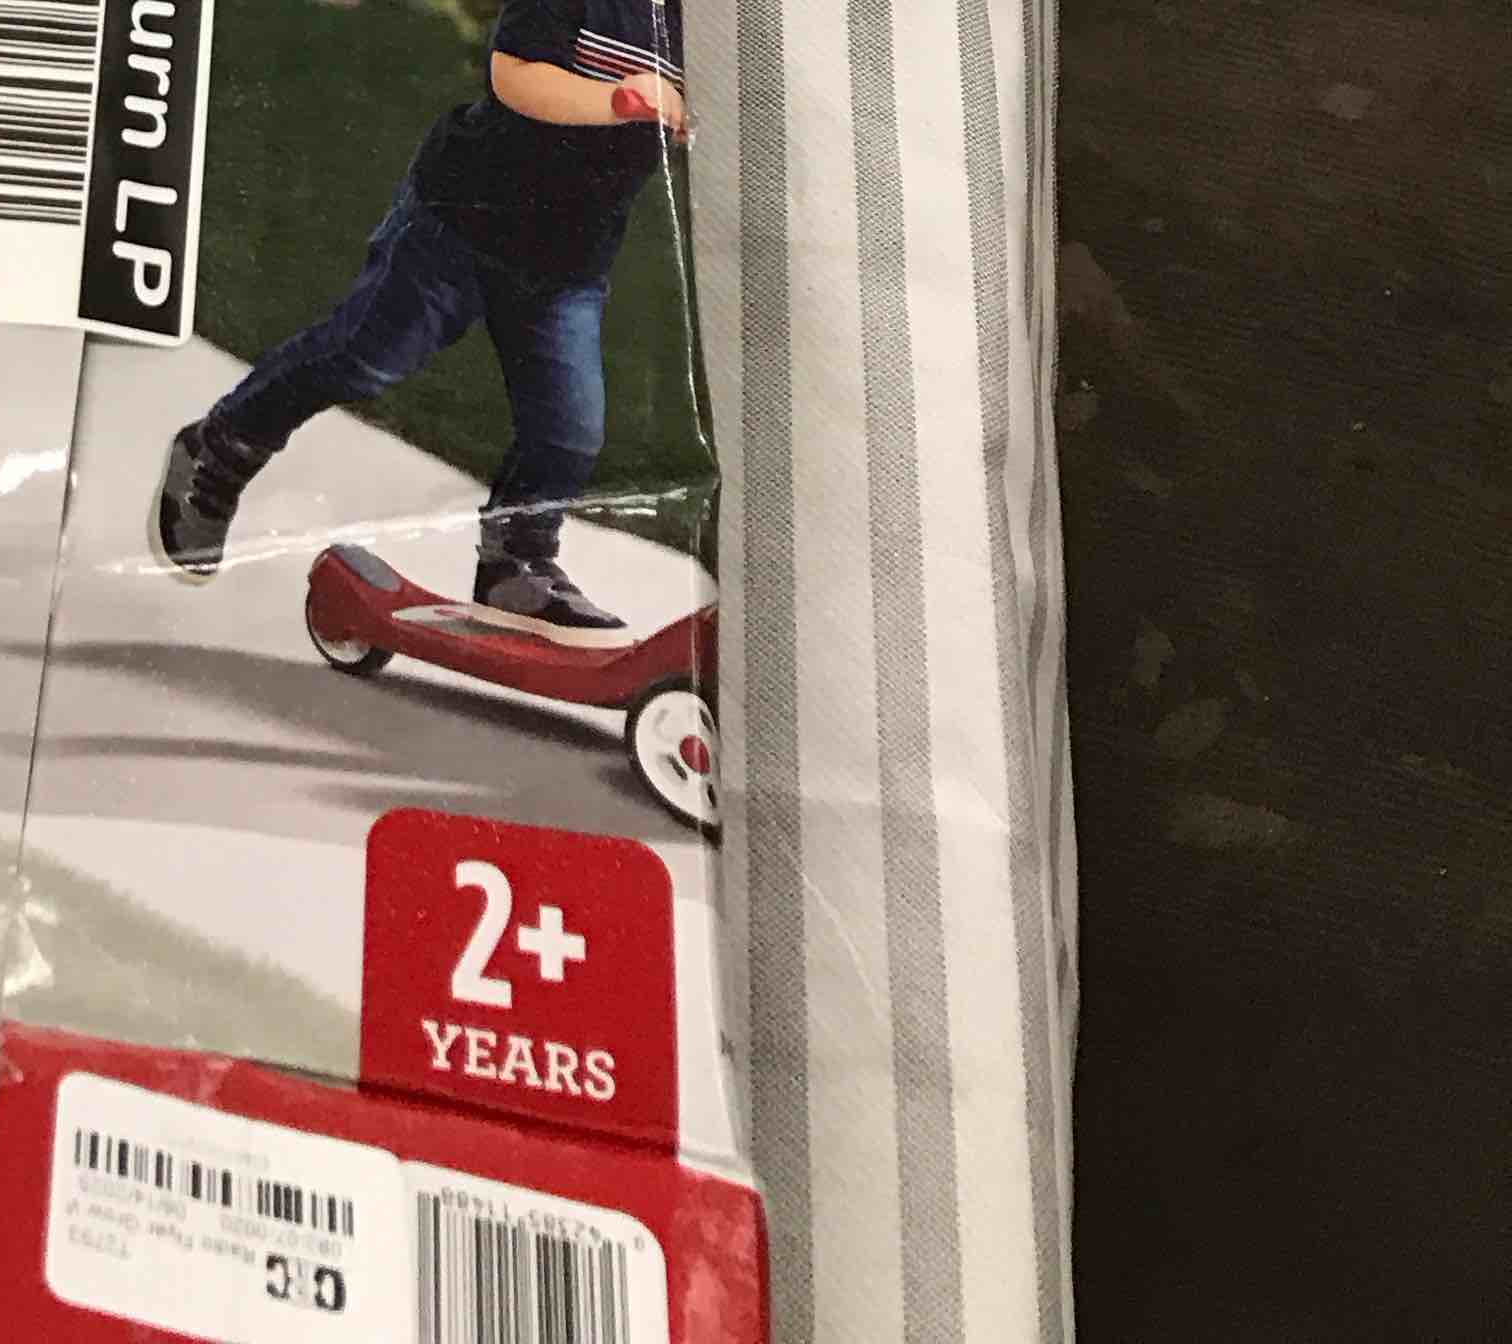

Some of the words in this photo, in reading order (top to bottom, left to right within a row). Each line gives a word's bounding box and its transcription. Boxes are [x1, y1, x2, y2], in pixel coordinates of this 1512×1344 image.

[110, 178, 179, 310] LP
[451, 859, 587, 1010] 2+
[421, 1018, 618, 1102] YEARS
